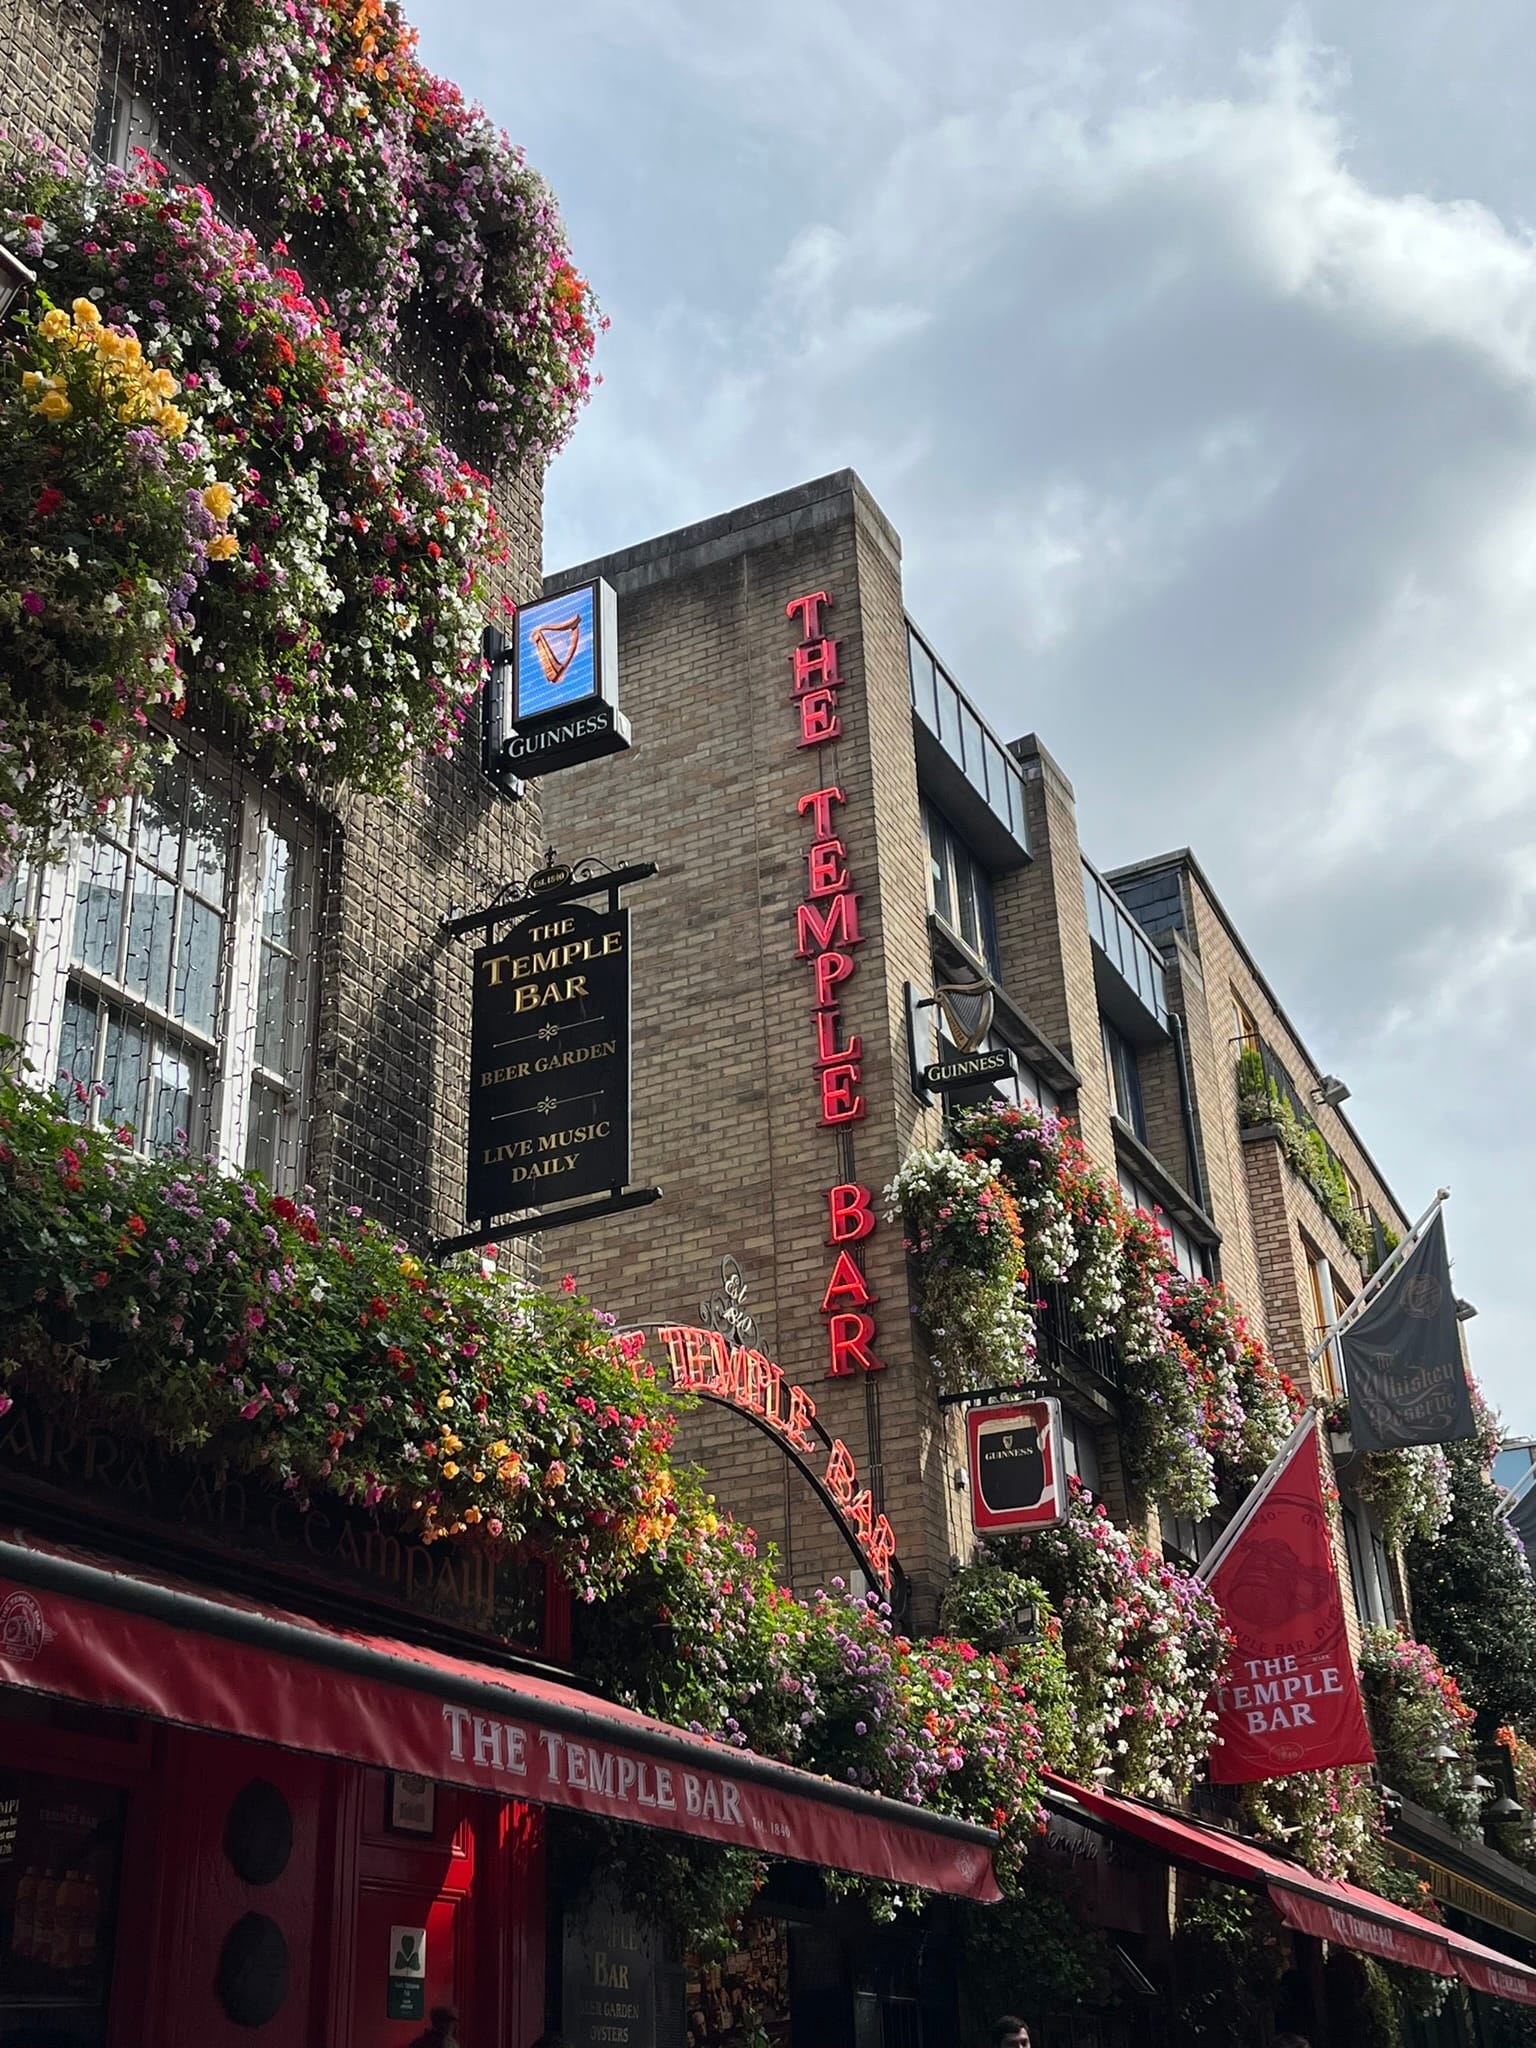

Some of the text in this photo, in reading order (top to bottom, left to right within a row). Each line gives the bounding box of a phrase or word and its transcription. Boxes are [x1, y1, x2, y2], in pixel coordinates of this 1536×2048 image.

[508, 713, 608, 758] GUINNESS
[529, 918, 576, 942] THE
[482, 931, 623, 987] TEMPLE
[513, 975, 590, 1014] BAR
[785, 591, 887, 1378] THE TEMPLE BAR
[480, 1040, 617, 1087] BEER GARDEN
[928, 1053, 1005, 1082] GUINNESS
[482, 1121, 611, 1165] LIVE MUSIC
[511, 1153, 580, 1184] DAILY
[658, 1326, 896, 1590] TEMPLE BAR
[984, 1446, 1034, 1461] GUINNESS
[1244, 1654, 1298, 1680] THE
[1214, 1667, 1344, 1713] TEMPLE
[1246, 1703, 1316, 1735] BAR
[443, 1703, 528, 1777] THE
[538, 1729, 677, 1811] TEMPLE
[683, 1772, 746, 1828] BAR
[771, 1822, 791, 1839] 1840
[593, 1951, 629, 1990] BAR
[602, 2001, 641, 2020] GARDEN
[591, 2024, 629, 2044] OYSTERS
